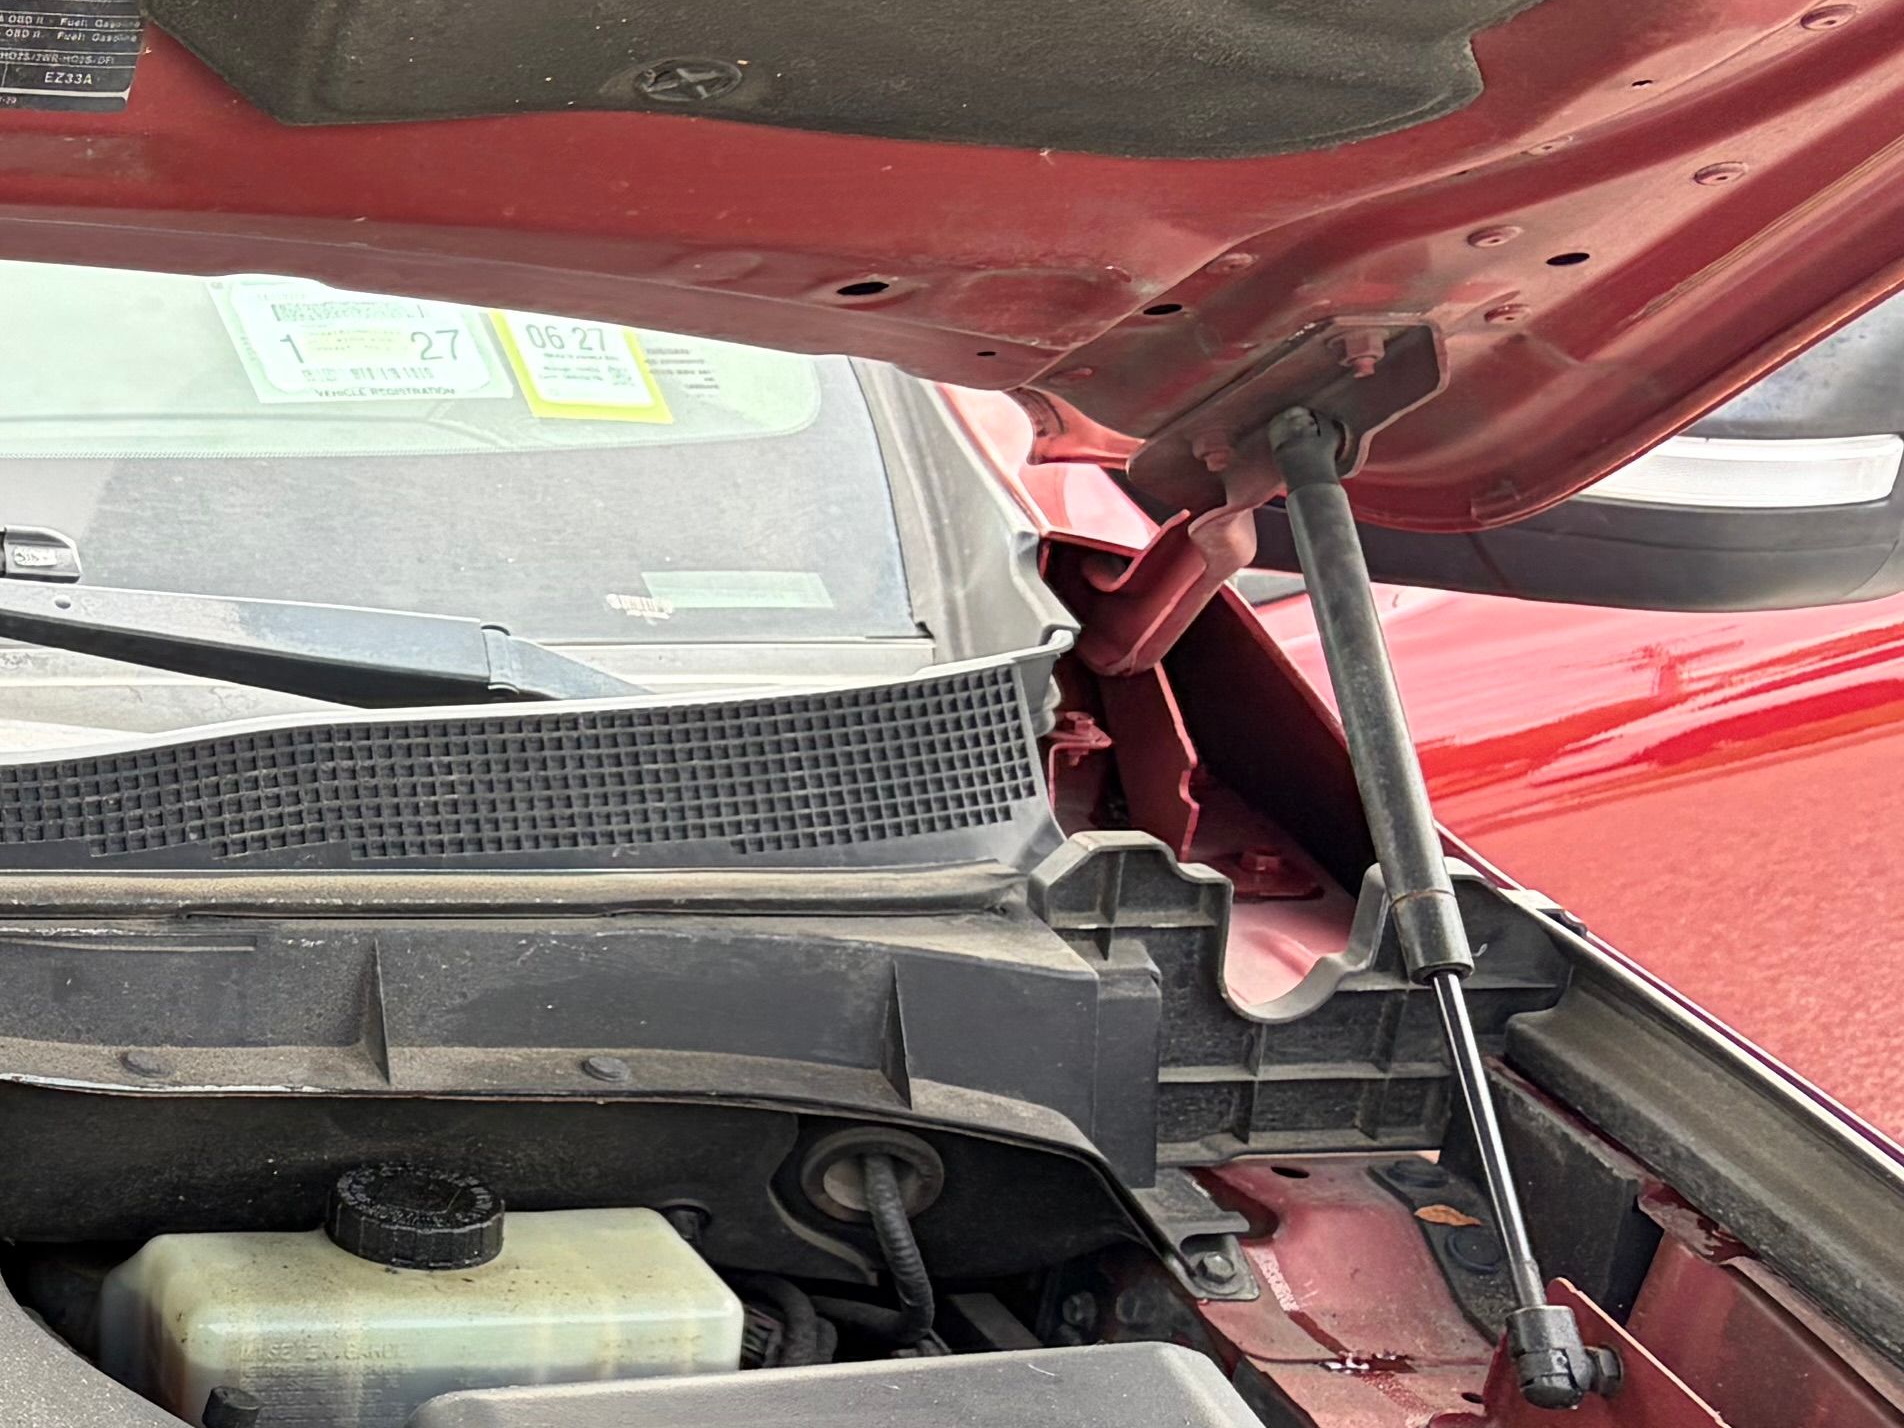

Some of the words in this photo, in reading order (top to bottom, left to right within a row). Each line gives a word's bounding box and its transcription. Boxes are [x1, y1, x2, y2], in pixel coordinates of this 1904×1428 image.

[8, 15, 33, 25] OBD
[5, 29, 30, 38] OBD
[44, 71, 92, 85] EZ33A
[410, 329, 460, 361] 27
[525, 324, 565, 350] 06
[571, 326, 606, 352] 27
